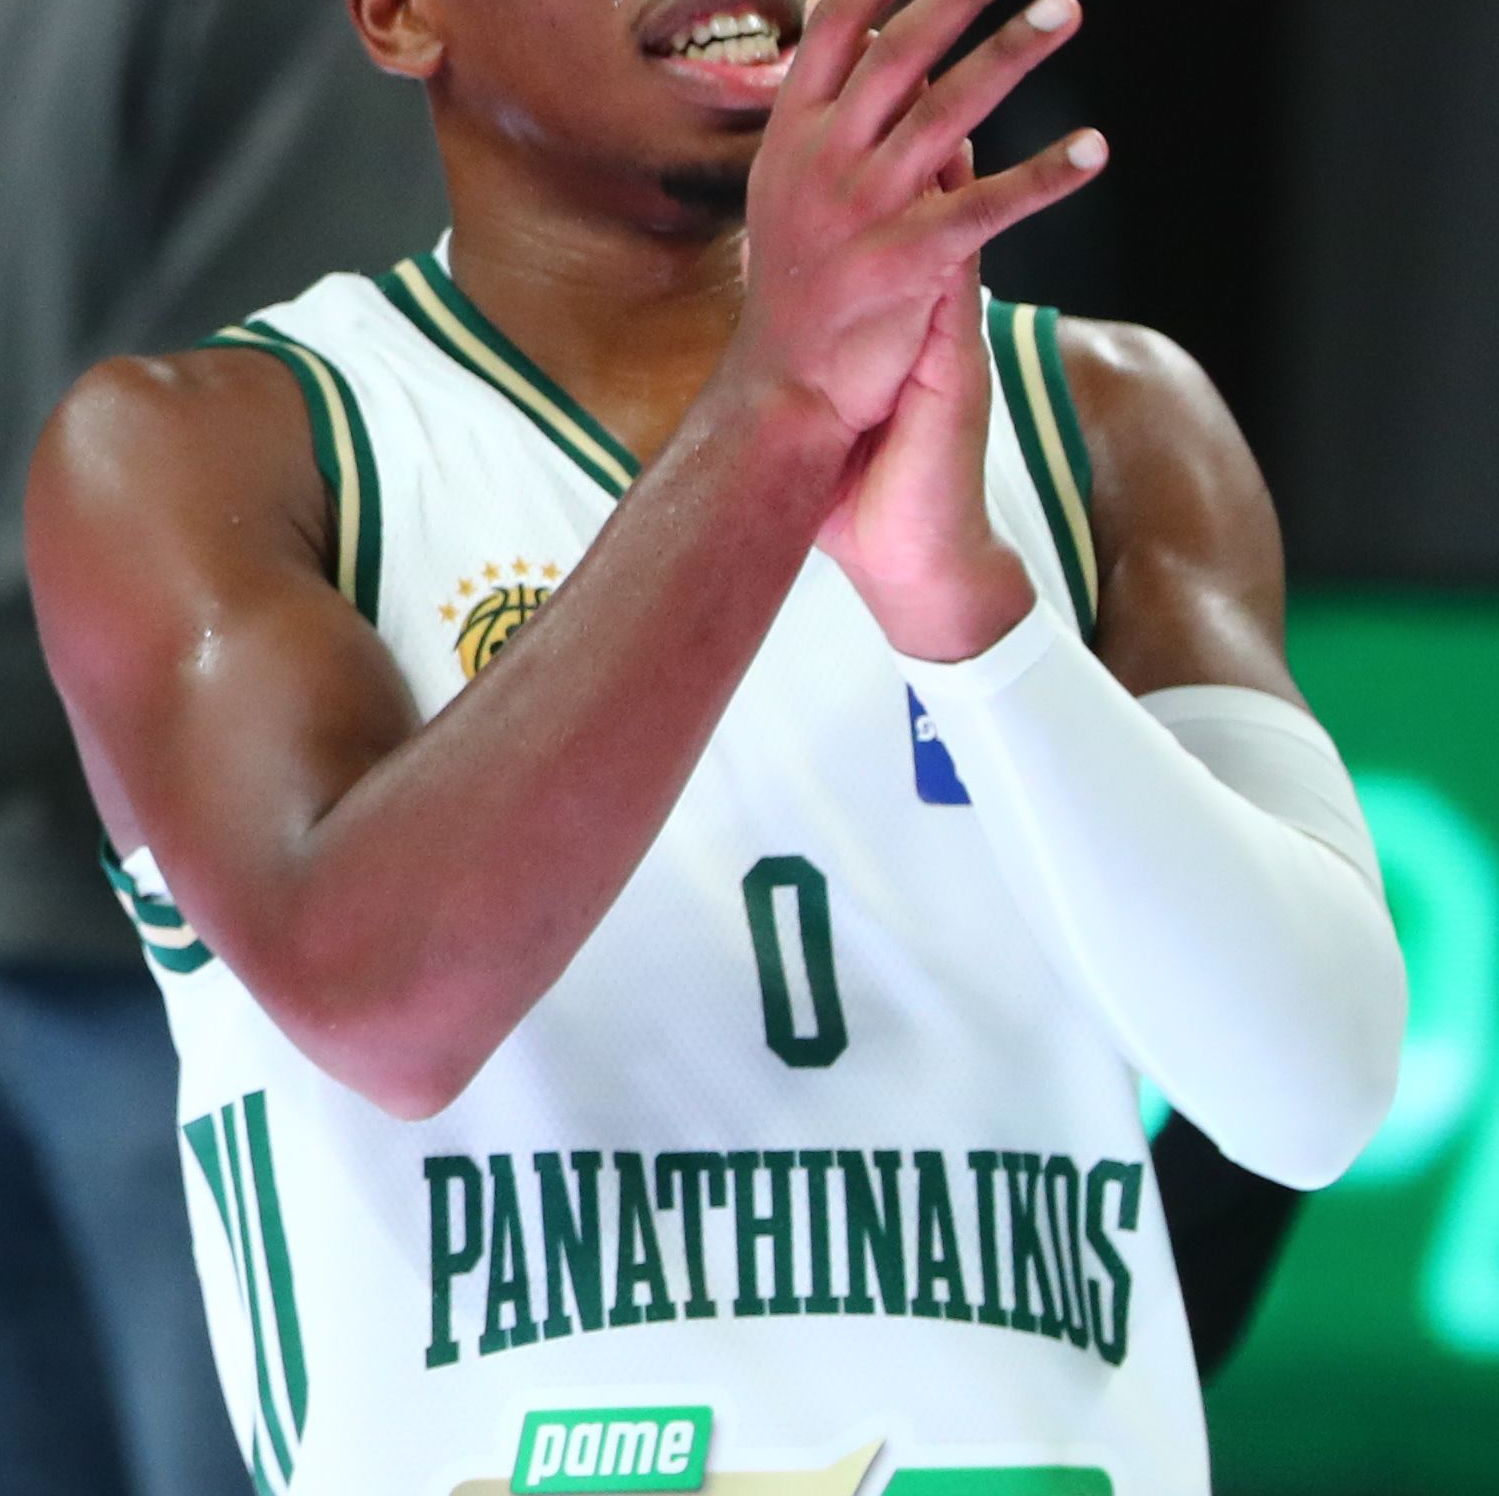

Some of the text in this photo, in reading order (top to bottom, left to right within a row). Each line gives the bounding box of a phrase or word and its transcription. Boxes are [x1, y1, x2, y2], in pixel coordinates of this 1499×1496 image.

[741, 855, 848, 1069] 0
[423, 1149, 1143, 1368] PANATHINAIKOS
[525, 1420, 696, 1487] pame
